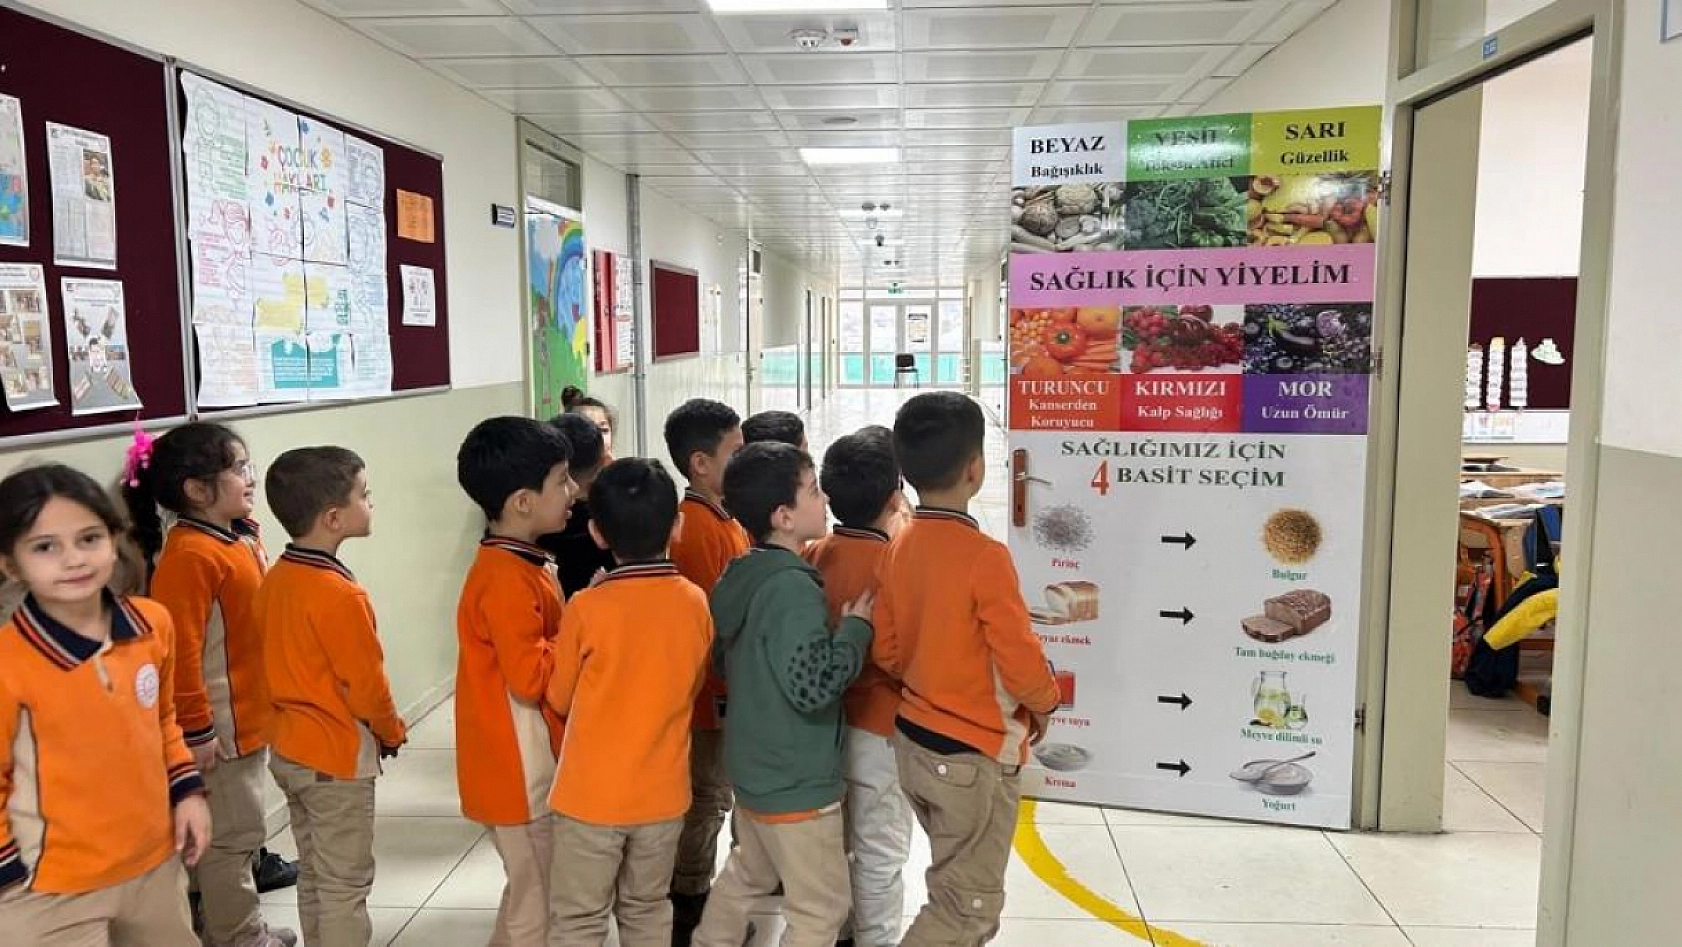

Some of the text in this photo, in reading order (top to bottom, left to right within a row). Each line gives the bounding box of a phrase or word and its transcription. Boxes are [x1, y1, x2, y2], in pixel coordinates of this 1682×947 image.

[1285, 121, 1346, 140] SARI
[1030, 136, 1105, 154] BEYAZ
[1280, 149, 1348, 166] Güzellik
[1031, 162, 1103, 178] Bağışıklık
[1030, 261, 1349, 292] SAĞLIK İÇİN YİYELİM
[1018, 380, 1109, 395] TURUNCU
[1135, 380, 1226, 396] KIRMIZI
[1278, 380, 1332, 397] MOR
[1029, 398, 1097, 411] Kanserden
[1138, 405, 1223, 420] Kalp Sağlığı
[1261, 404, 1349, 420] Uzun Ömür
[1031, 416, 1094, 429] Koruyucu
[1061, 438, 1286, 461] SAĞLIĞIMIZ İÇİN
[1091, 460, 1285, 496] 4 BASİT SEÇİM
[1271, 569, 1307, 582] Bulgur
[1233, 646, 1256, 658] Tam
[1262, 798, 1296, 812] Yoğurt
